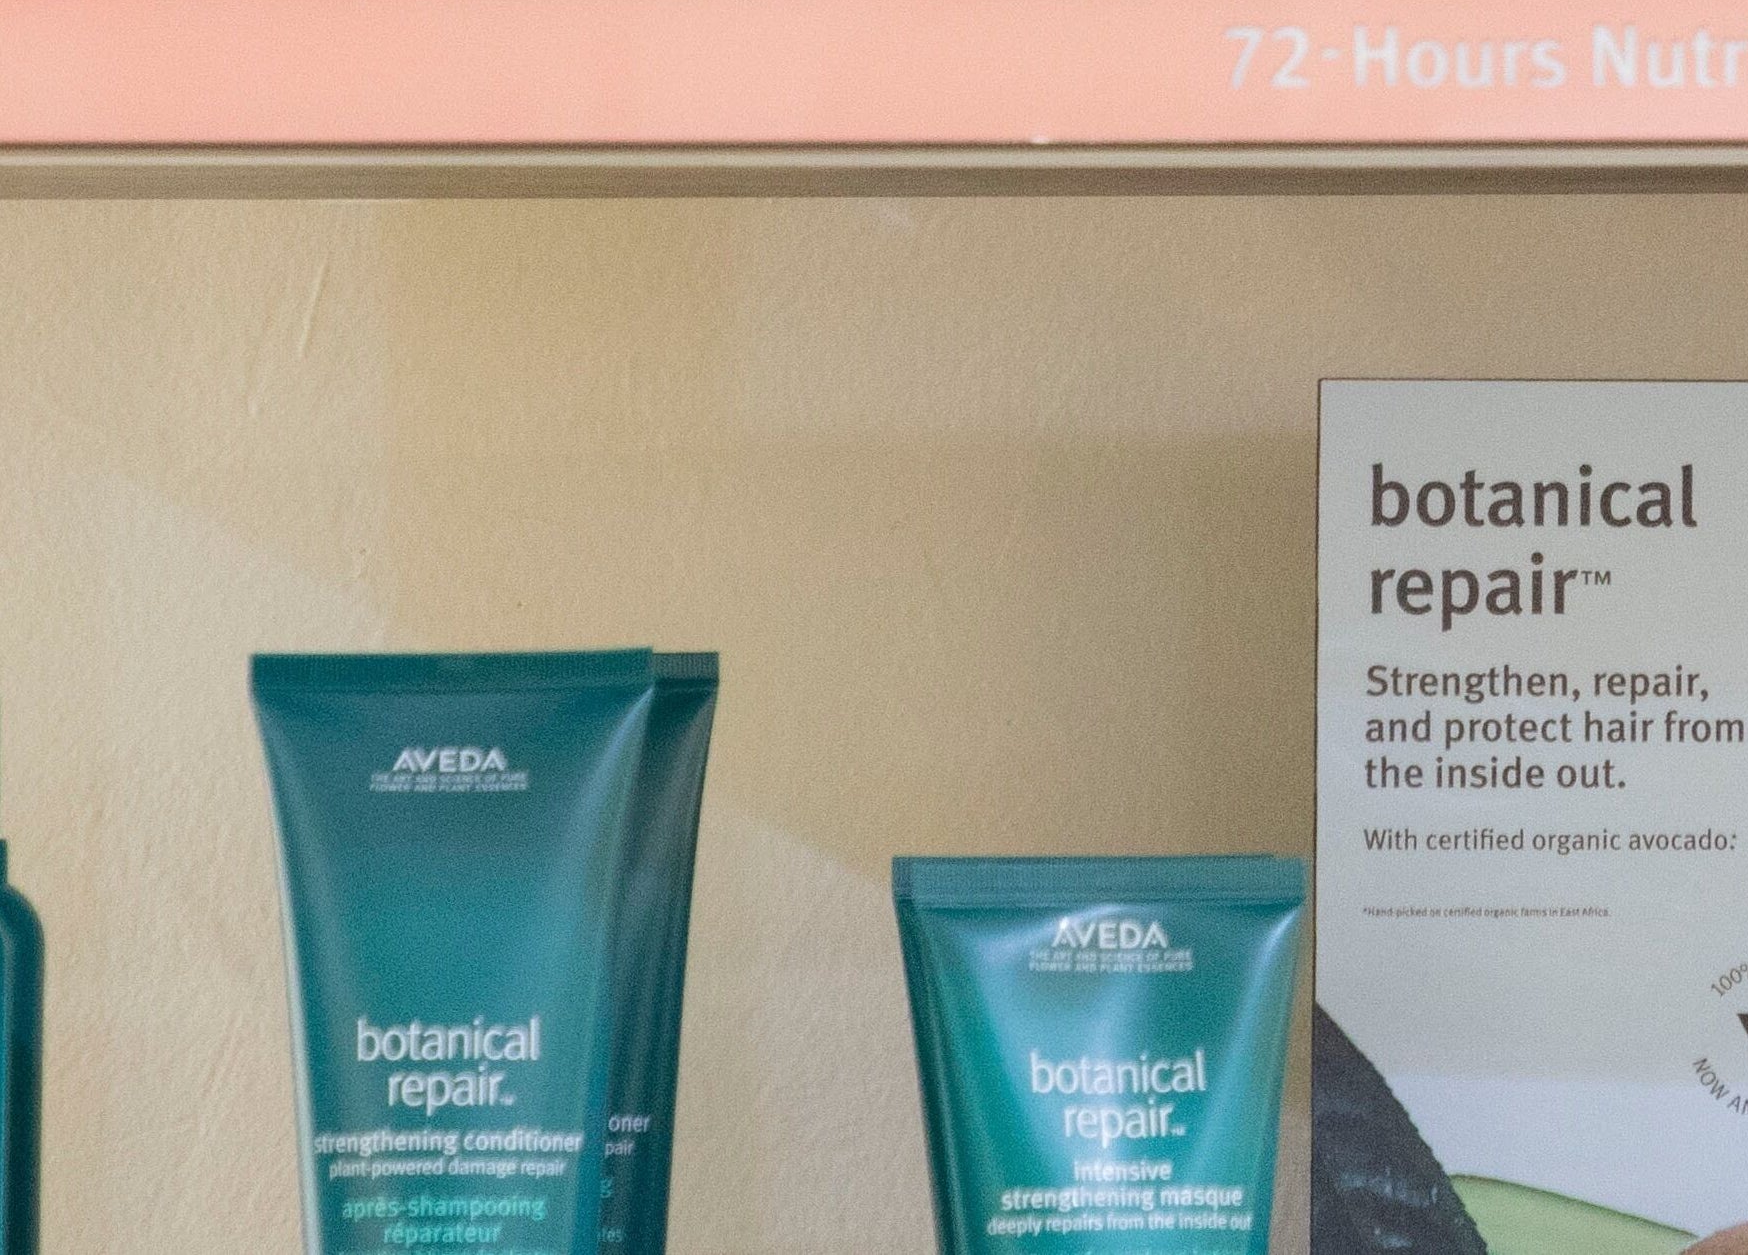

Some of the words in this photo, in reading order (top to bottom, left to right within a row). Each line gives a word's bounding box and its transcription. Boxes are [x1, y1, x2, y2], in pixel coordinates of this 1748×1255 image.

[1224, 22, 1567, 90] 72-Hours
[1371, 463, 1698, 528] botanical
[1370, 553, 1612, 632] repair™
[1366, 665, 1581, 704] Strengthen,
[1593, 665, 1709, 704] repair,
[1365, 712, 1430, 742] and
[1444, 711, 1573, 749] protect
[1584, 711, 1654, 742] hair
[1664, 711, 1745, 742] from
[392, 747, 506, 773] AVEDA
[1365, 757, 1423, 788] the
[1436, 757, 1544, 788] inside
[1557, 759, 1625, 788] out.
[1364, 828, 1417, 851] With
[1426, 828, 1524, 851] certified
[1533, 830, 1621, 855] organic
[1444, 907, 1482, 917] certified
[1484, 908, 1518, 919] organic
[1560, 907, 1580, 917] East
[1052, 920, 1168, 948] AVEDA
[357, 1015, 541, 1062] botanical
[1030, 1048, 1206, 1094] botanical
[1693, 1058, 1729, 1100] NOW
[315, 1128, 457, 1157] strengthening
[464, 1126, 583, 1152] conditioner
[329, 1160, 444, 1180] plant-powered
[449, 1160, 516, 1178] damage
[521, 1160, 565, 1178] repair
[1074, 1161, 1173, 1181] intensive
[342, 1192, 546, 1221] après-shampooing
[1001, 1188, 1154, 1210] strengthening
[1160, 1187, 1244, 1209] masque
[384, 1222, 500, 1244] réparateur
[988, 1220, 1041, 1237] deeply
[1045, 1214, 1101, 1233] repairs
[1107, 1213, 1145, 1229] from
[1149, 1212, 1173, 1229] the
[1178, 1213, 1227, 1230] inside
[1230, 1213, 1252, 1230] out
